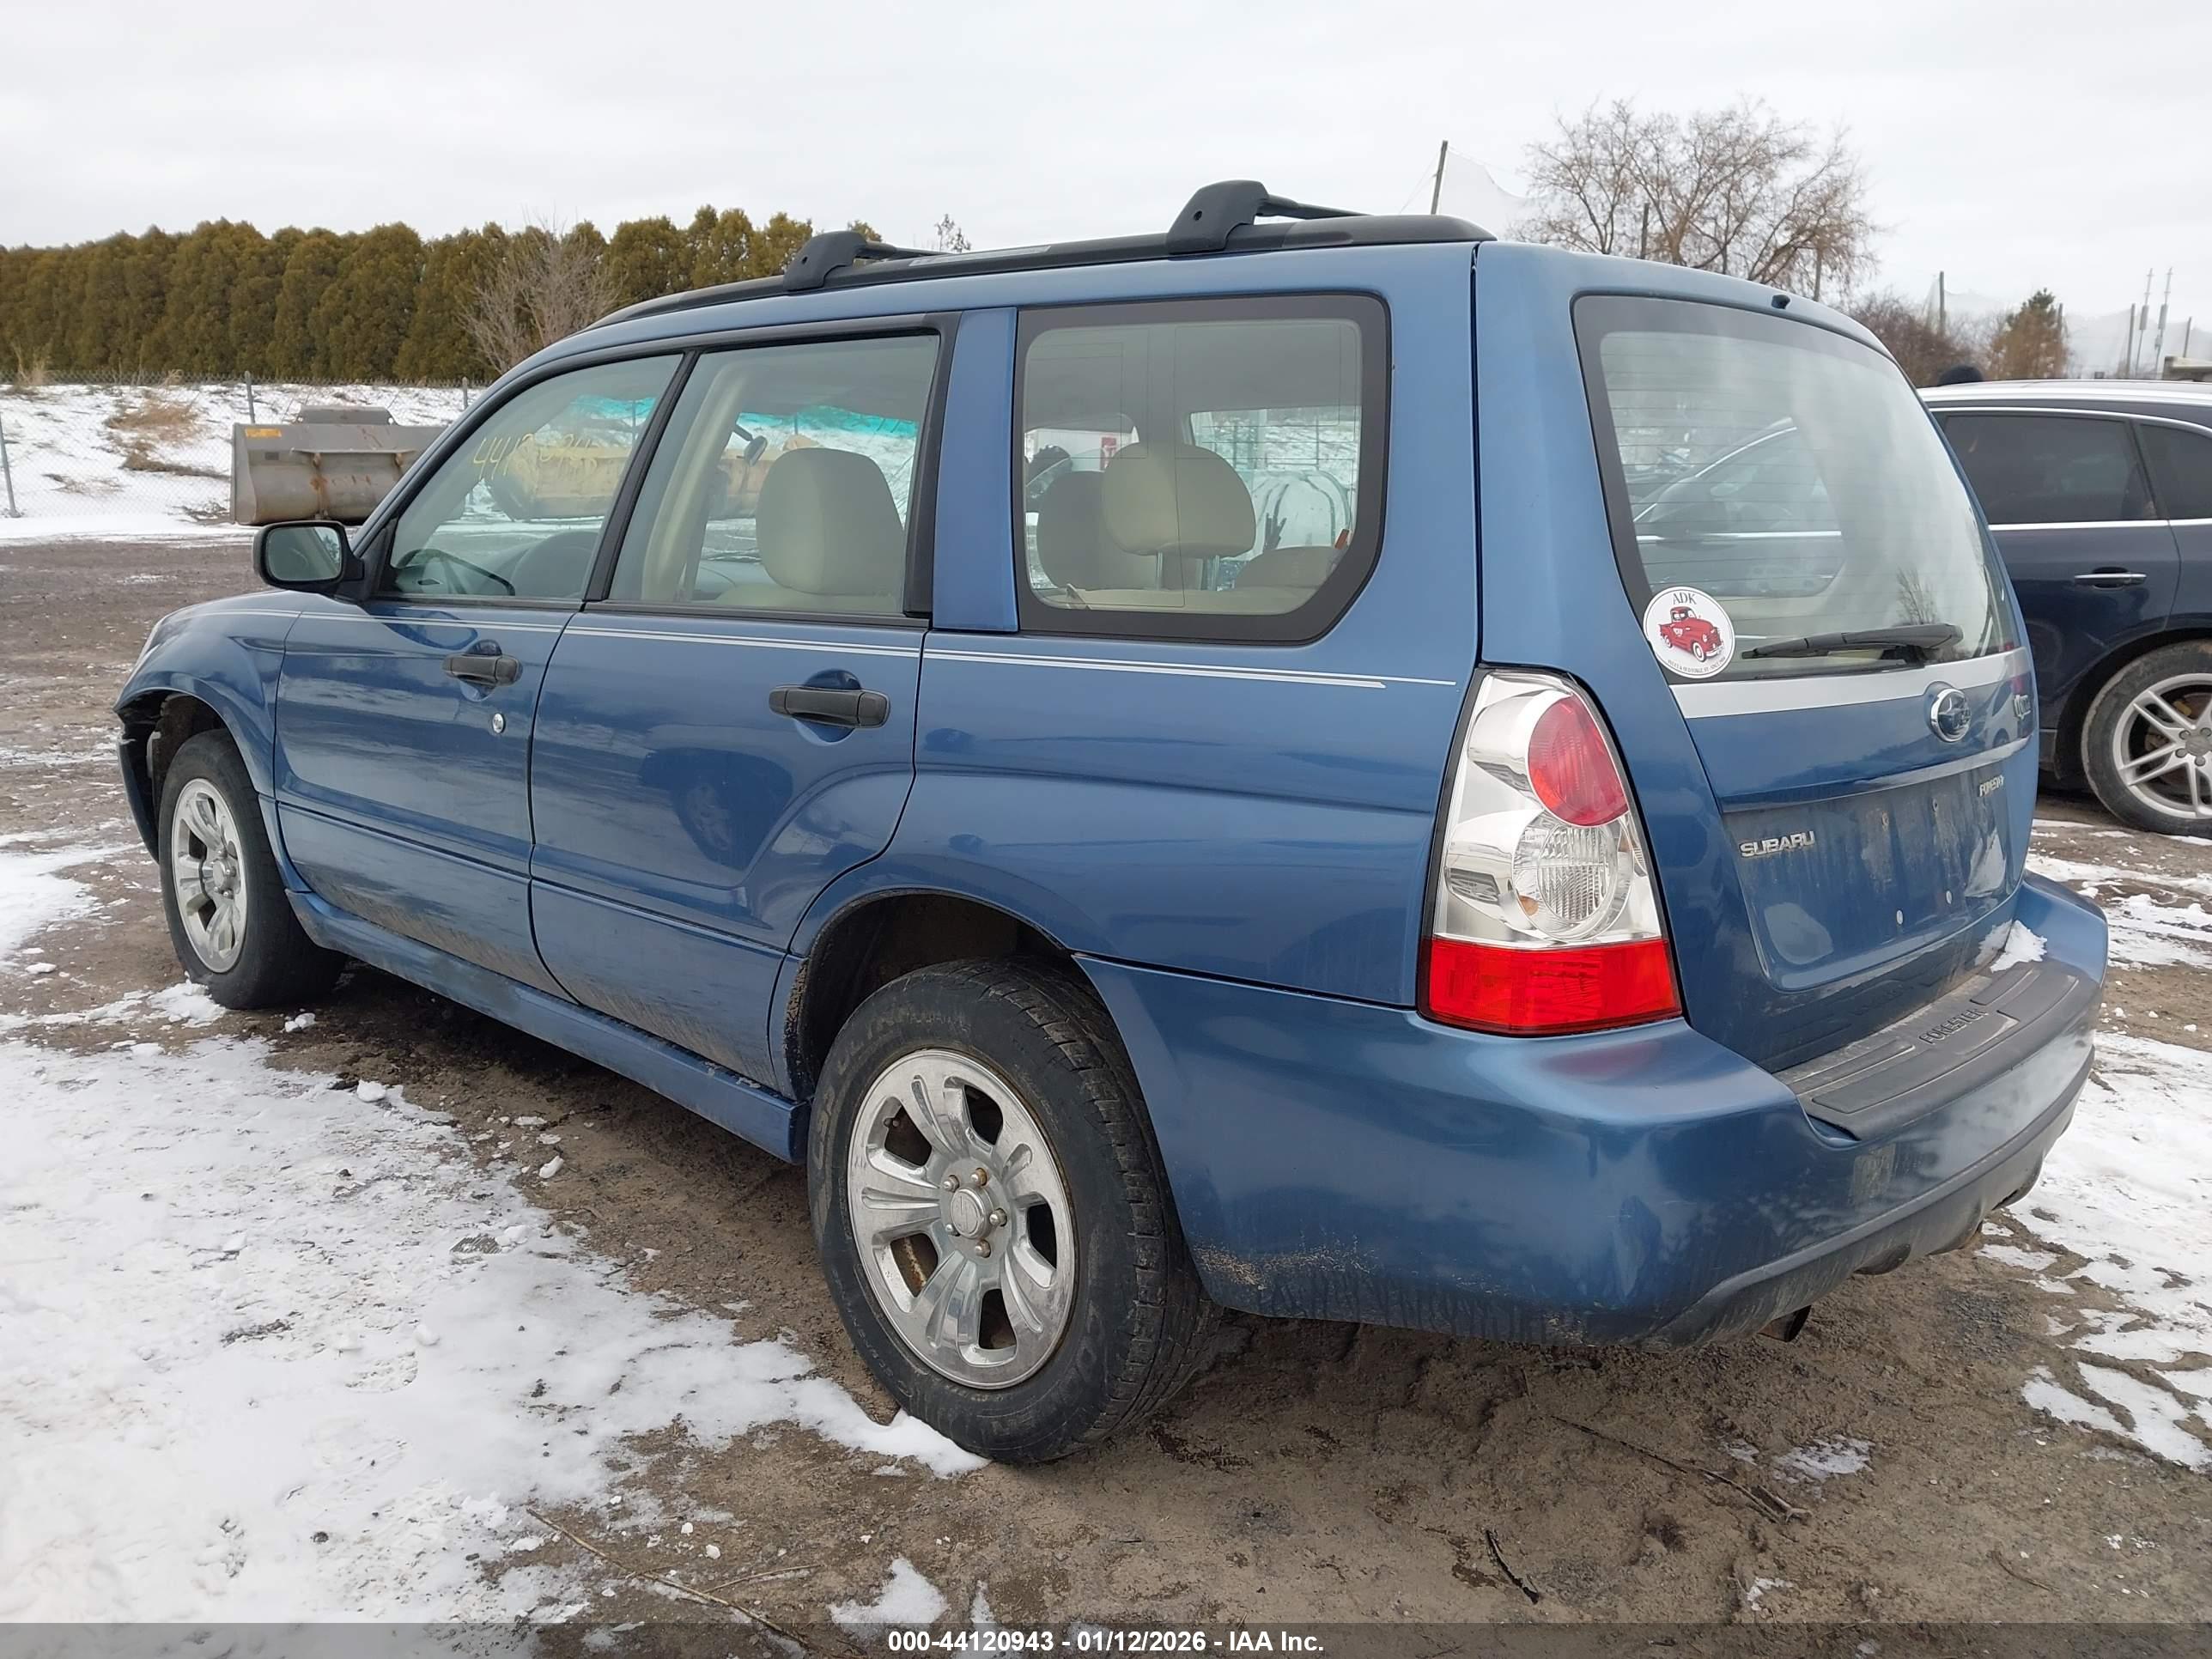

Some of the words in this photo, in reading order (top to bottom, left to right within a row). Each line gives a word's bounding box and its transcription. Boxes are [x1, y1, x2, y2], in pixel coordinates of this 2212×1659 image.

[1674, 592, 1697, 605] ADK
[1740, 830, 1815, 857] SUBARU
[1918, 1007, 1989, 1045] FORESTER
